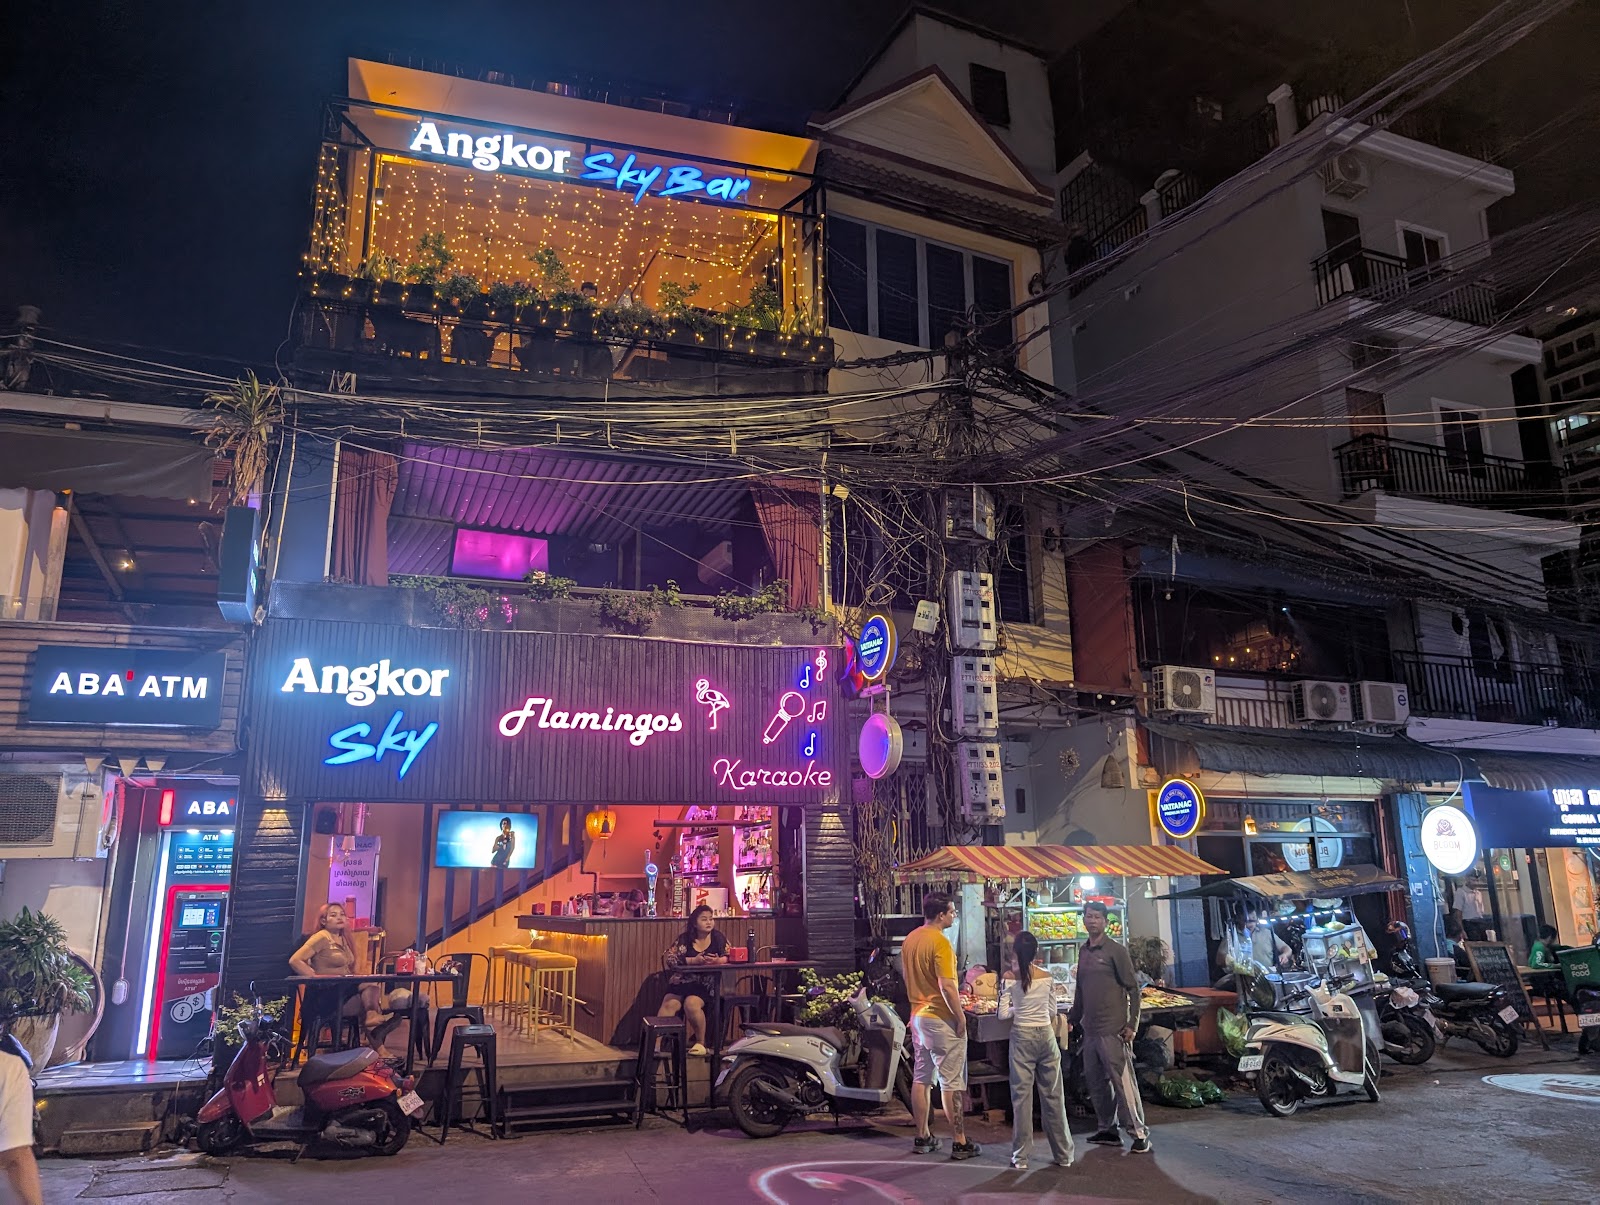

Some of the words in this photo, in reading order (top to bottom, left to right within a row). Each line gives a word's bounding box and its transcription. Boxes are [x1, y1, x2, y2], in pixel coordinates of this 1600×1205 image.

[409, 122, 571, 174] Angkor
[579, 151, 662, 206] Sky
[657, 165, 751, 201] Bar
[138, 675, 208, 699] ATM
[280, 657, 450, 707] Angkor
[498, 697, 683, 747] Flamingos
[322, 709, 440, 781] Sky
[713, 758, 832, 790] Karaoke
[1160, 799, 1193, 812] VATTANAC
[1433, 840, 1461, 851] BLOOM
[1570, 962, 1588, 971] Grab
[1571, 968, 1590, 978] Food
